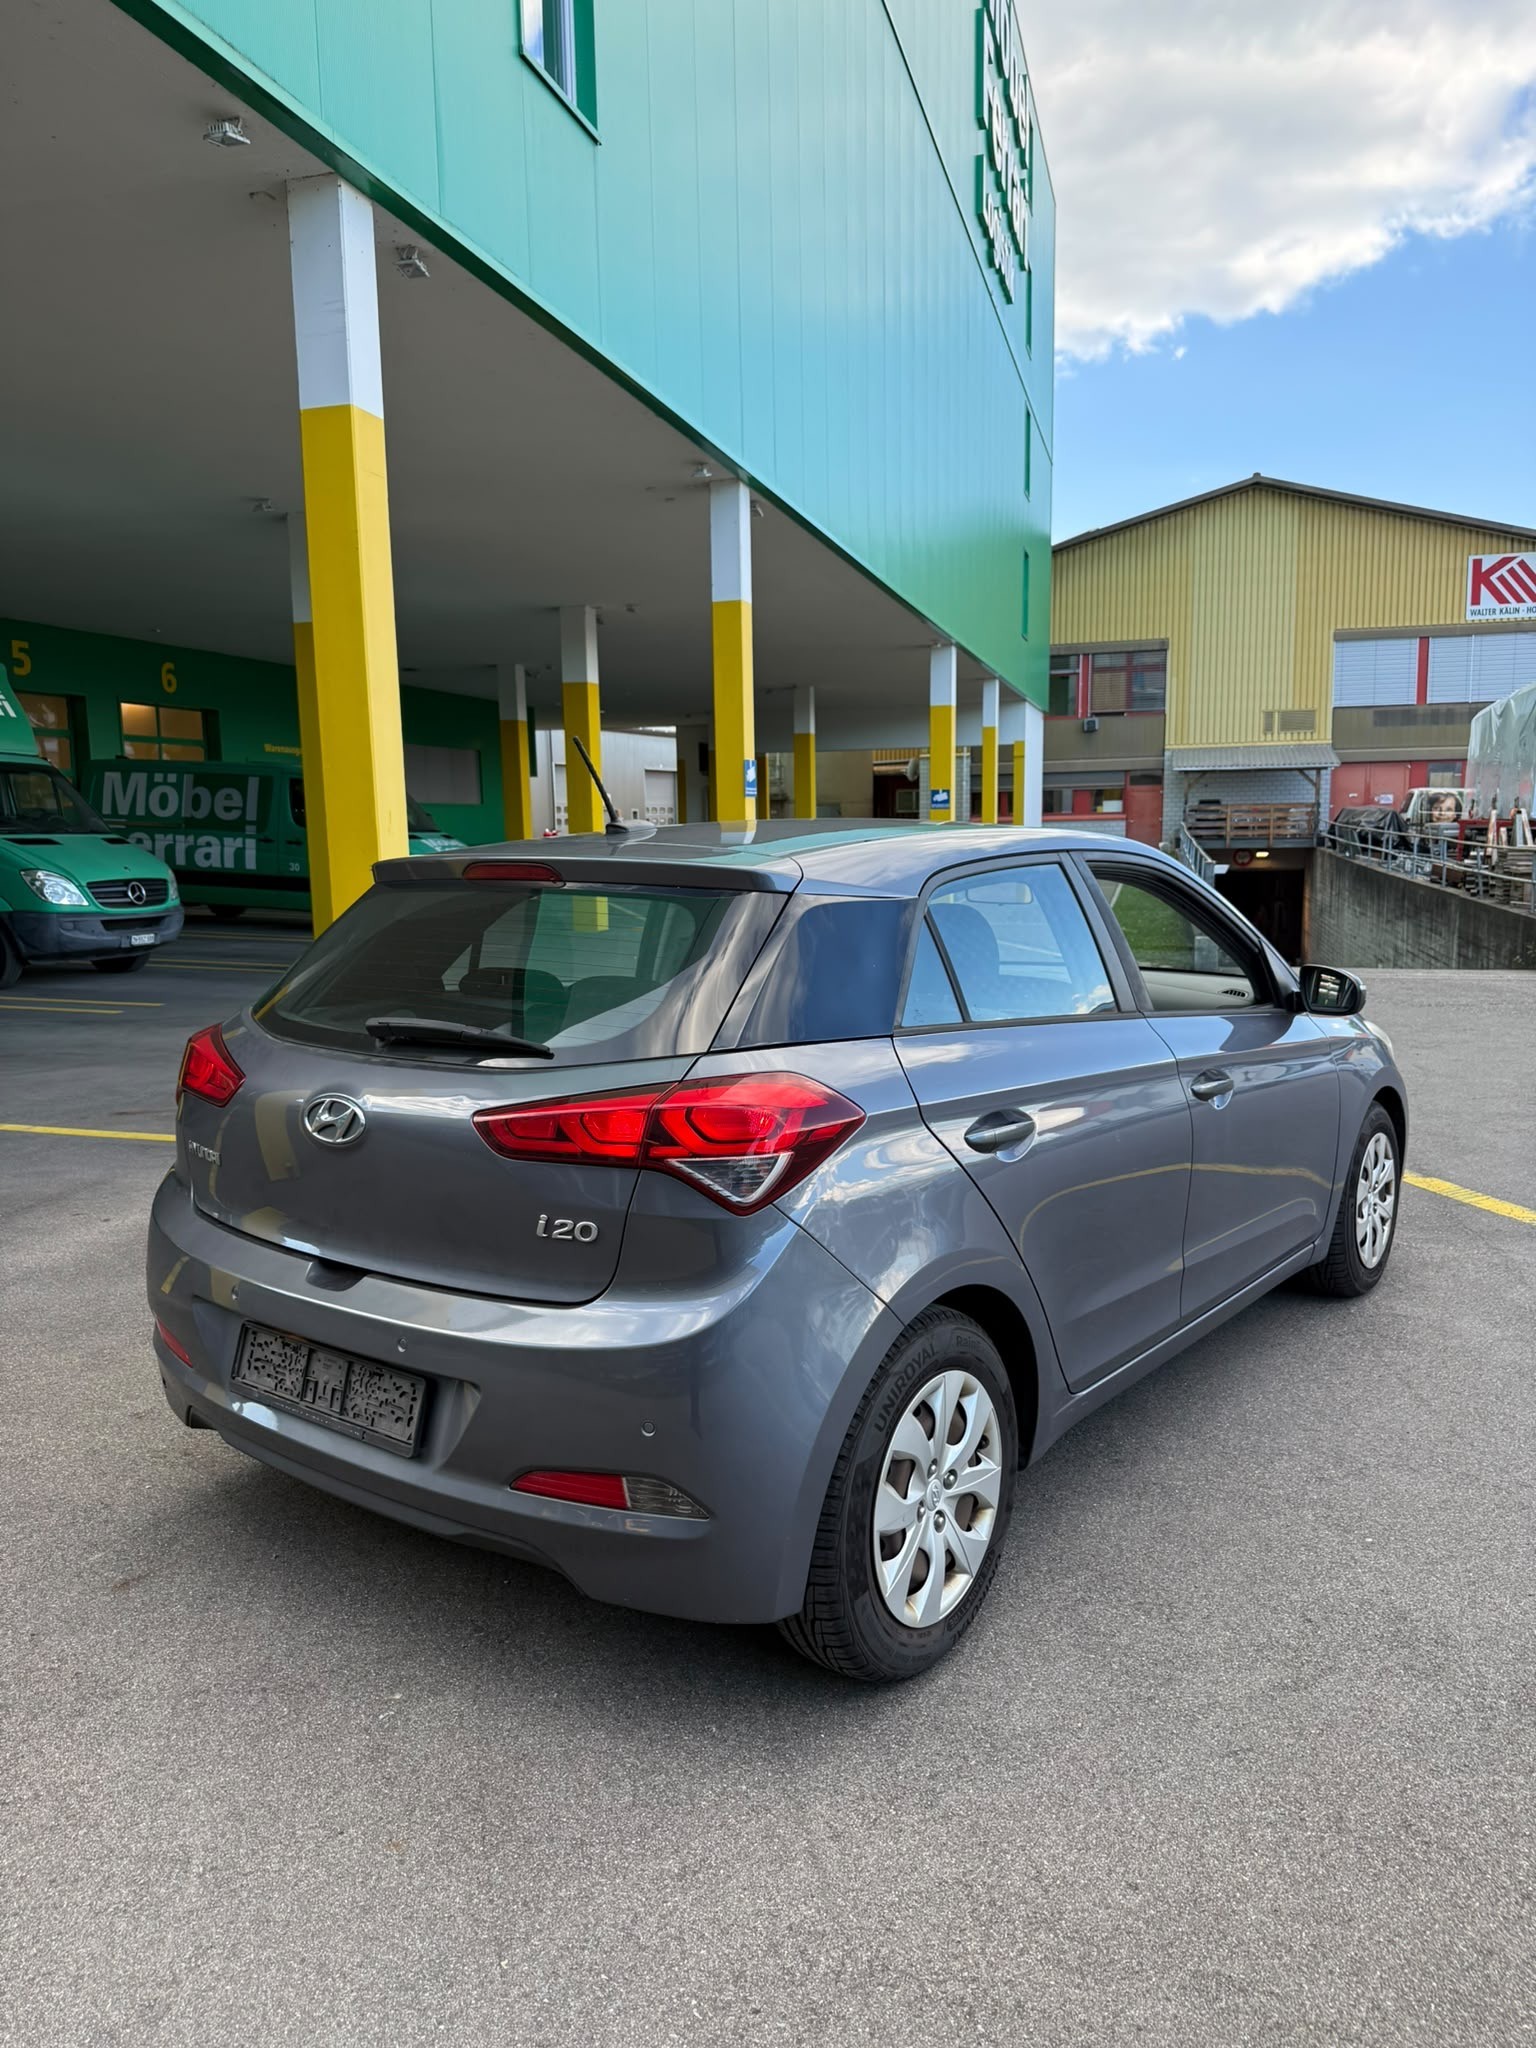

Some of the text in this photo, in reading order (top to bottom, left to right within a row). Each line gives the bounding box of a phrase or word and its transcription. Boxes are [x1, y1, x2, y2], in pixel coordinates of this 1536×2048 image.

[1470, 608, 1497, 617] WALTER
[11, 639, 32, 677] 5
[160, 662, 178, 694] 6
[101, 771, 260, 821] Möbel
[105, 818, 257, 870] errari
[289, 862, 301, 872] 30
[536, 1214, 599, 1242] i20
[874, 1342, 937, 1434] UNIROYAL
